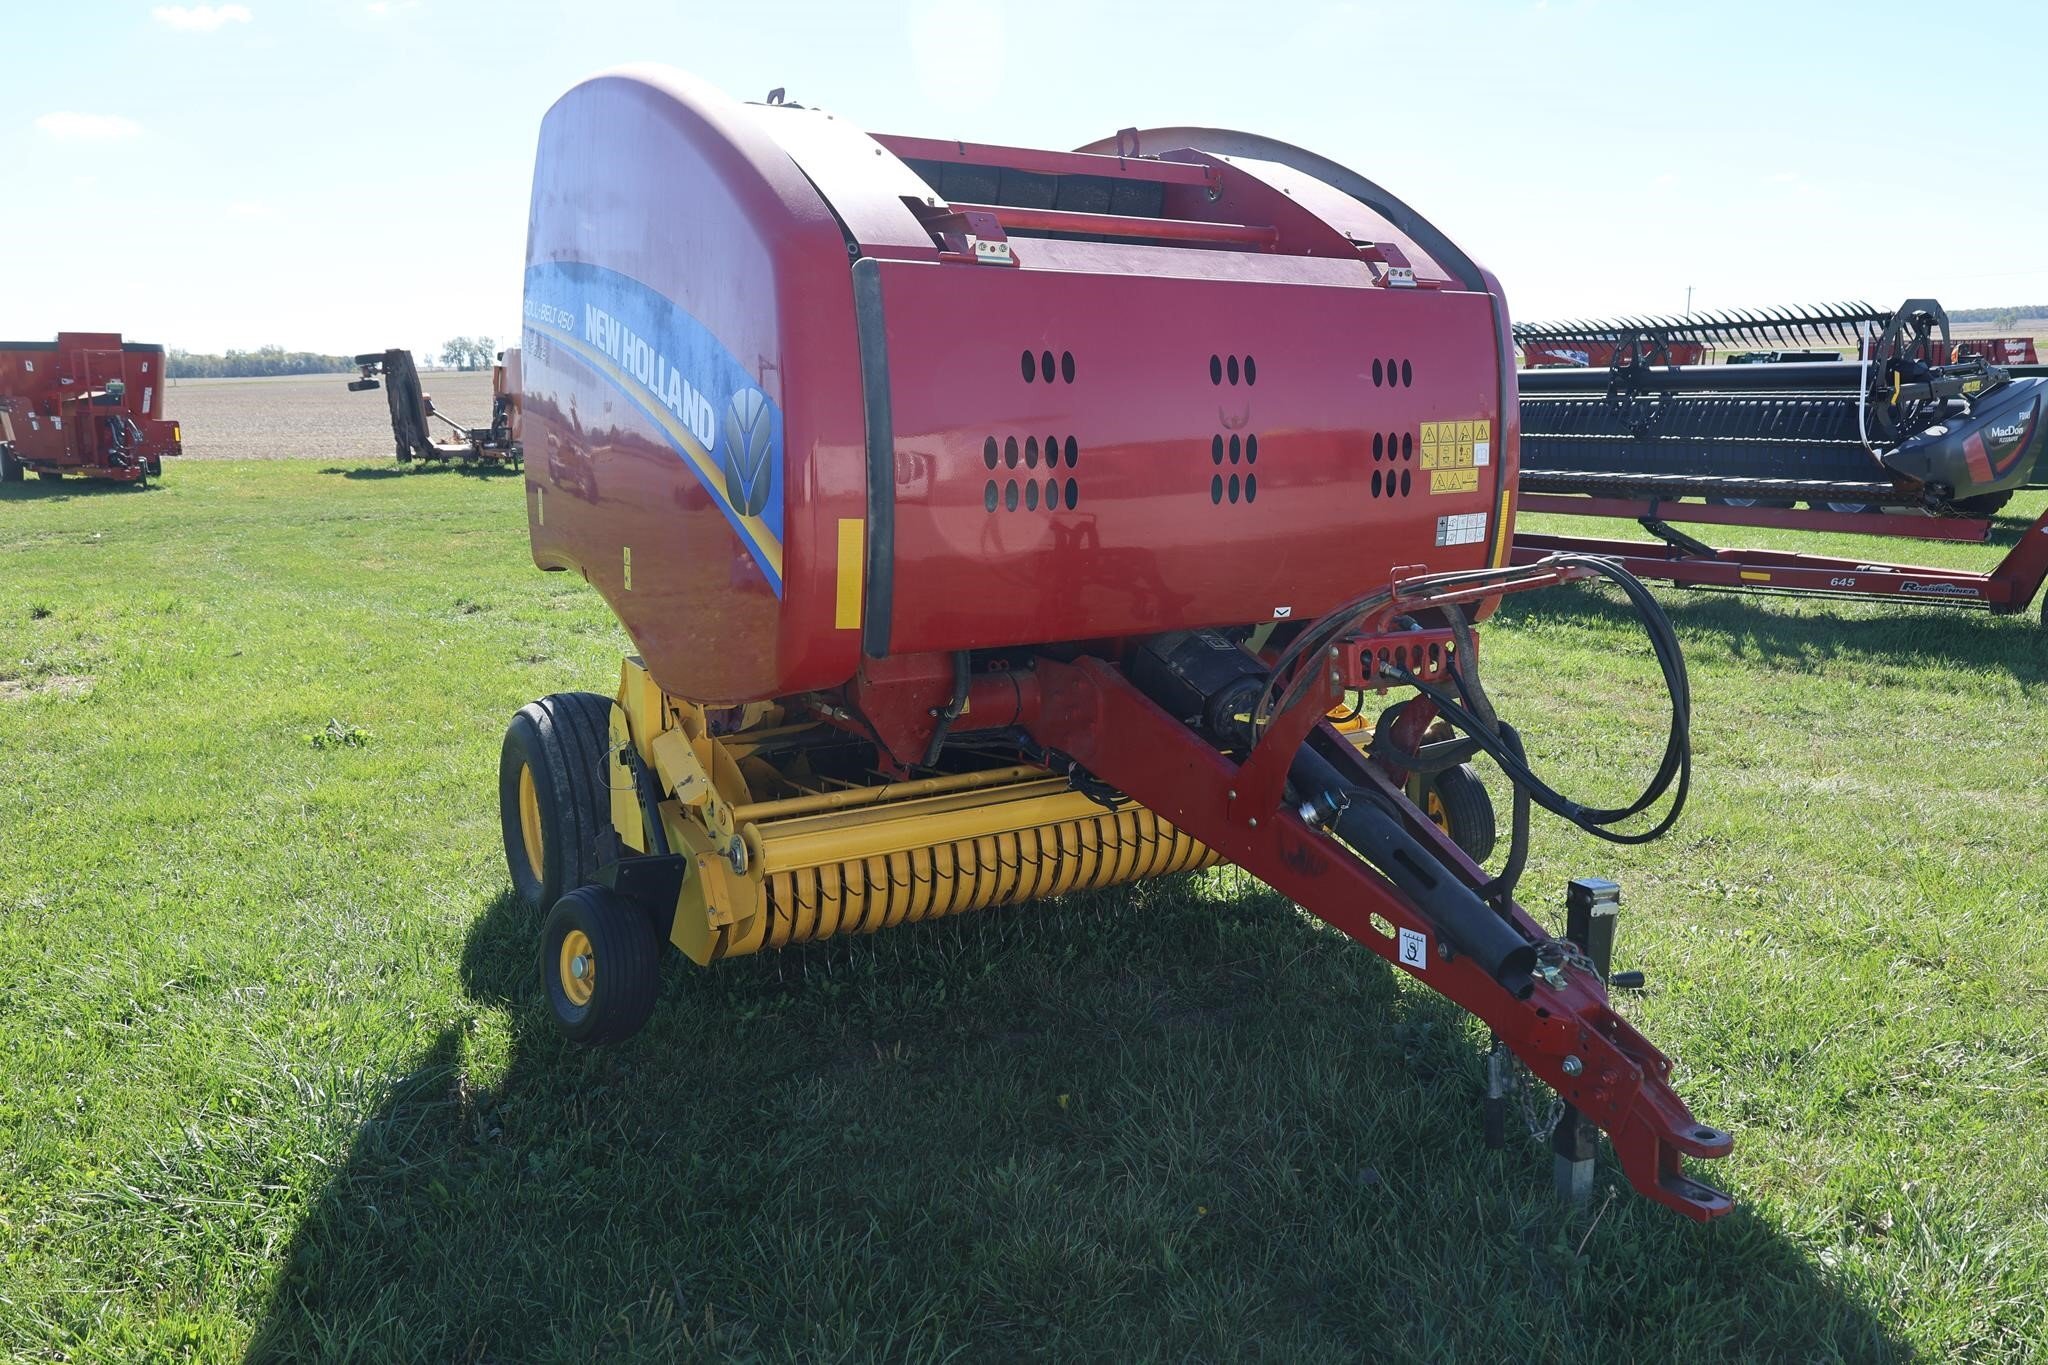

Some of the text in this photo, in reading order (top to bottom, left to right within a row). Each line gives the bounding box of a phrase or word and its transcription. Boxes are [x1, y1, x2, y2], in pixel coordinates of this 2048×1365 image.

[557, 310, 575, 331] 450
[585, 303, 715, 451] NEW HOLLAND
[1830, 577, 1856, 587] 645
